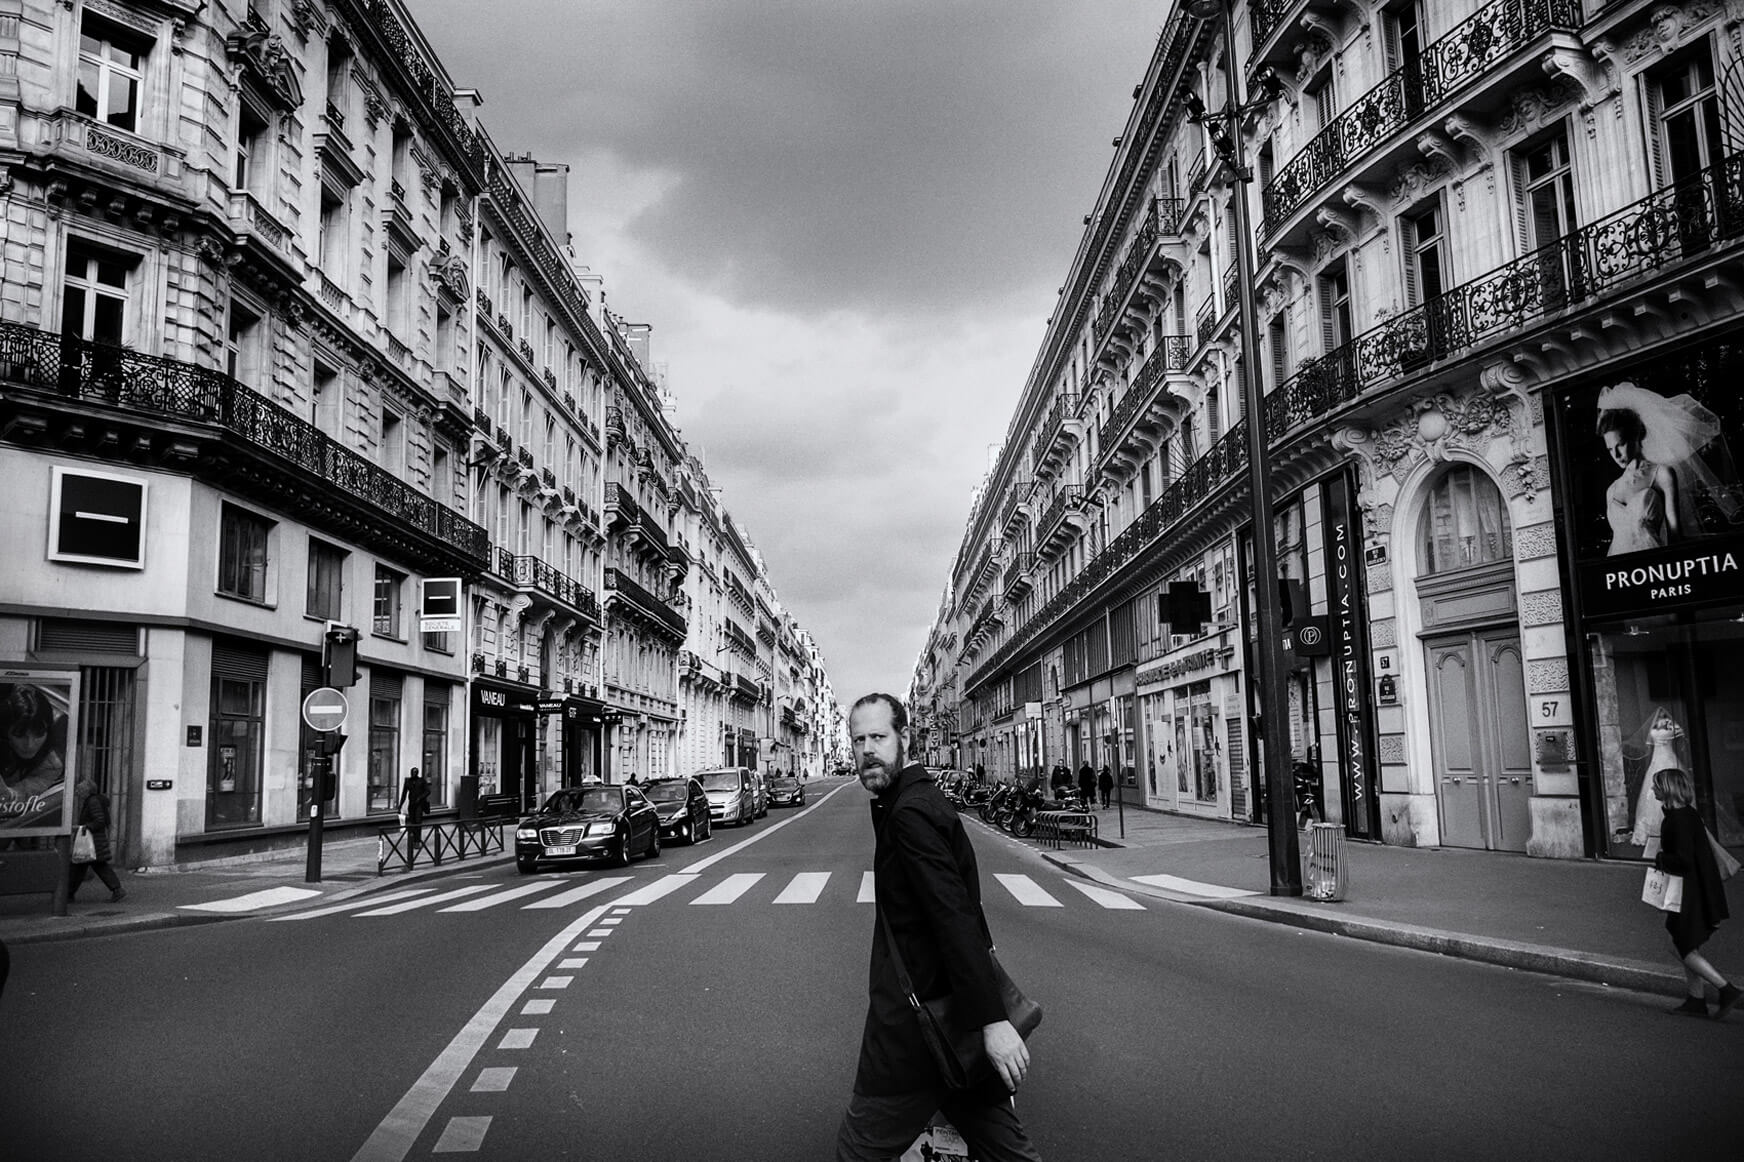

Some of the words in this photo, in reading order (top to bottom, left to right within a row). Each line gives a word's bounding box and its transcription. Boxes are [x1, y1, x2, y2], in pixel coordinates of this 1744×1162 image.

[1606, 553, 1738, 590] PRONUPTIA
[1651, 584, 1691, 599] PARIS
[1335, 524, 1363, 800] WWW.PRONUPTIA.COM
[480, 689, 506, 706] VANEAU
[1542, 701, 1559, 717] 57
